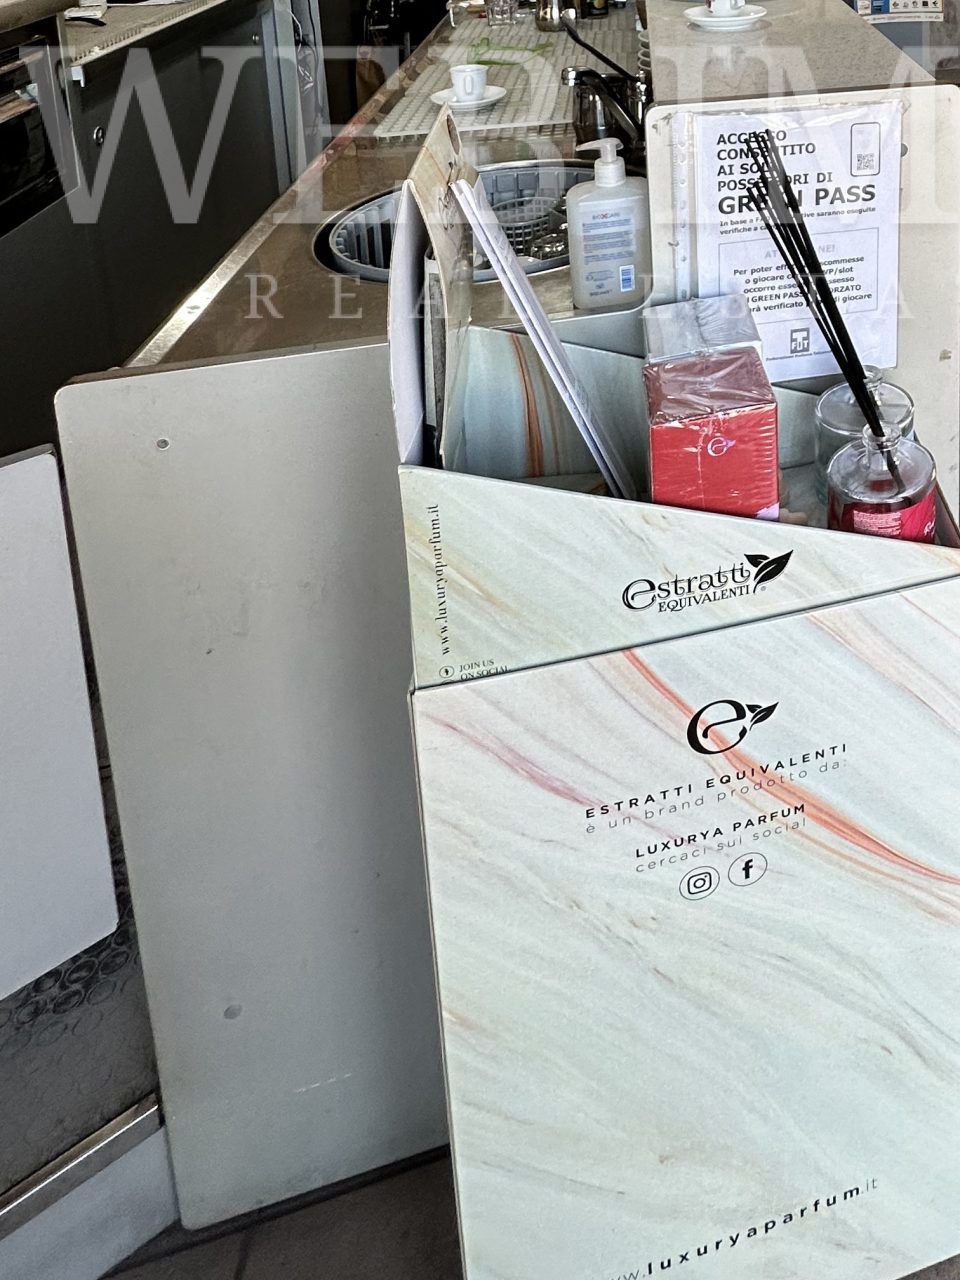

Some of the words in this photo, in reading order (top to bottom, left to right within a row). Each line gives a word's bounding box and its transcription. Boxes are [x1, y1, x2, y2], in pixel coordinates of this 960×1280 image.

[716, 130, 787, 146] ACCESO
[717, 143, 816, 161] CONSTITO
[717, 165, 734, 176] AI
[739, 162, 768, 175] SOL
[817, 172, 833, 183] DI
[815, 184, 876, 206] PASS
[817, 209, 845, 217] saranno
[720, 226, 752, 235] verifiche
[734, 268, 748, 276] Per
[751, 266, 772, 276] poter
[753, 275, 784, 285] giocare
[744, 285, 775, 293] occorre
[751, 294, 781, 303] GREEN
[764, 301, 803, 311] verificato
[842, 293, 872, 303] giocare
[426, 504, 450, 656] www.luxuryaparfum.it
[621, 562, 751, 610] estratti
[658, 584, 750, 613] EQUIVALENTI
[459, 660, 480, 673] JOIN
[482, 658, 494, 667] US
[460, 672, 475, 681] ON
[476, 666, 511, 677] SOCIAL
[586, 783, 692, 819] ESTRATTI
[706, 743, 847, 789] EQUIVALENTI
[586, 822, 595, 834] è
[608, 816, 632, 830] un
[645, 796, 705, 820] brand
[717, 769, 808, 802] prodotto
[635, 827, 724, 858] LUXURYA
[733, 803, 805, 833] PARFUM
[635, 847, 707, 873] cercaci
[717, 837, 742, 851] sui
[752, 818, 806, 841] social
[611, 1177, 878, 1280] w.luxuryaparfum.it
